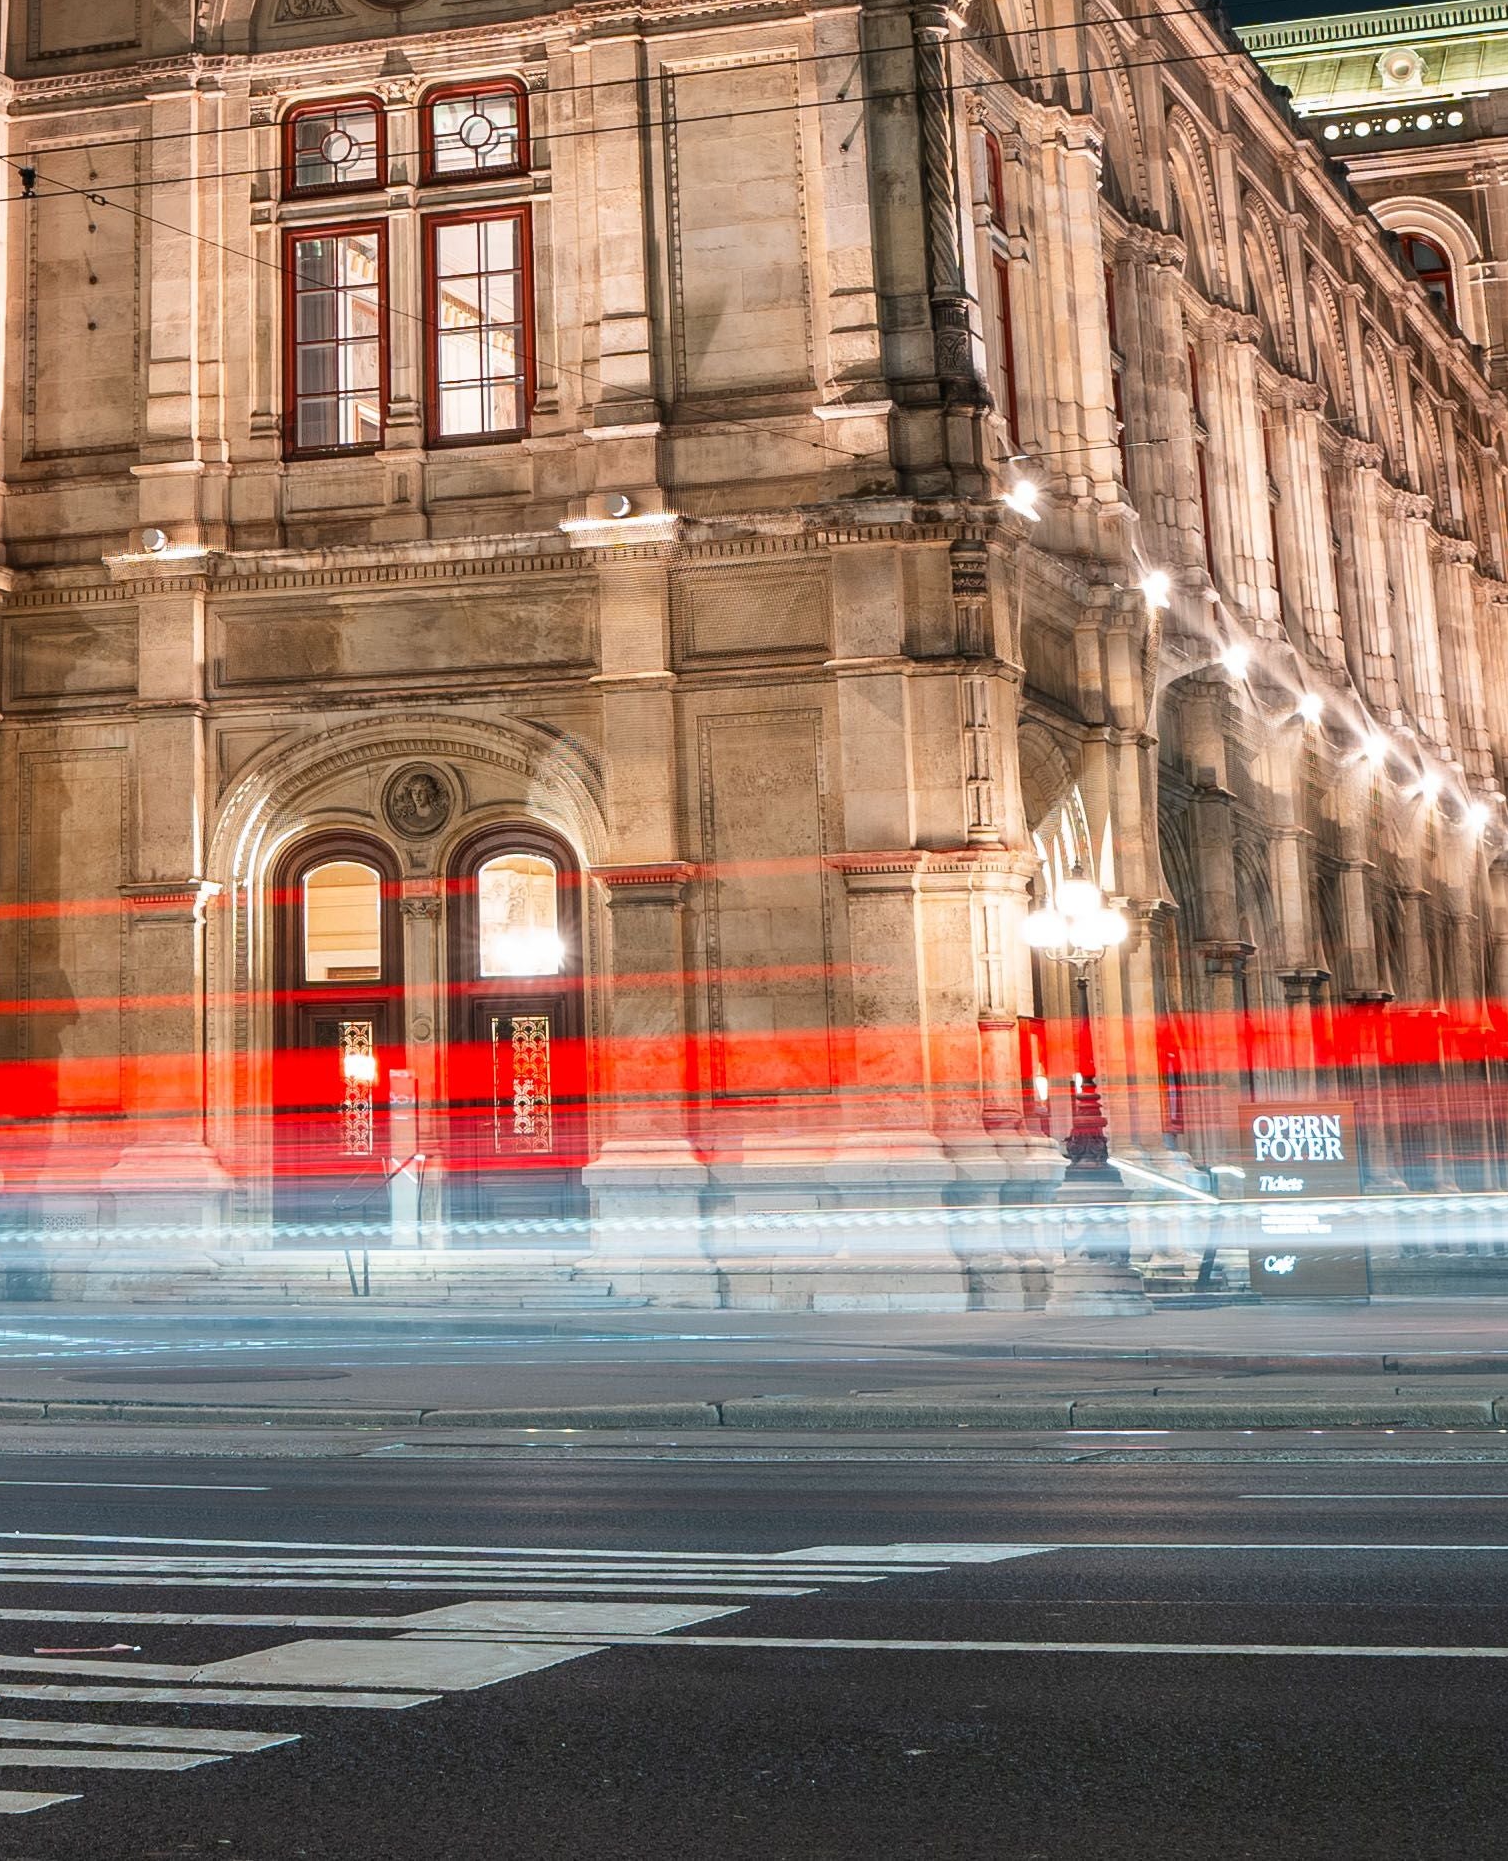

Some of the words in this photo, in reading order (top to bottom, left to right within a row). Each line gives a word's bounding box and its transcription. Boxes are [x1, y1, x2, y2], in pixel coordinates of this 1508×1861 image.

[1253, 1115, 1341, 1139] OPERN
[1255, 1138, 1344, 1161] FOYER
[1259, 1175, 1304, 1191] Tickets
